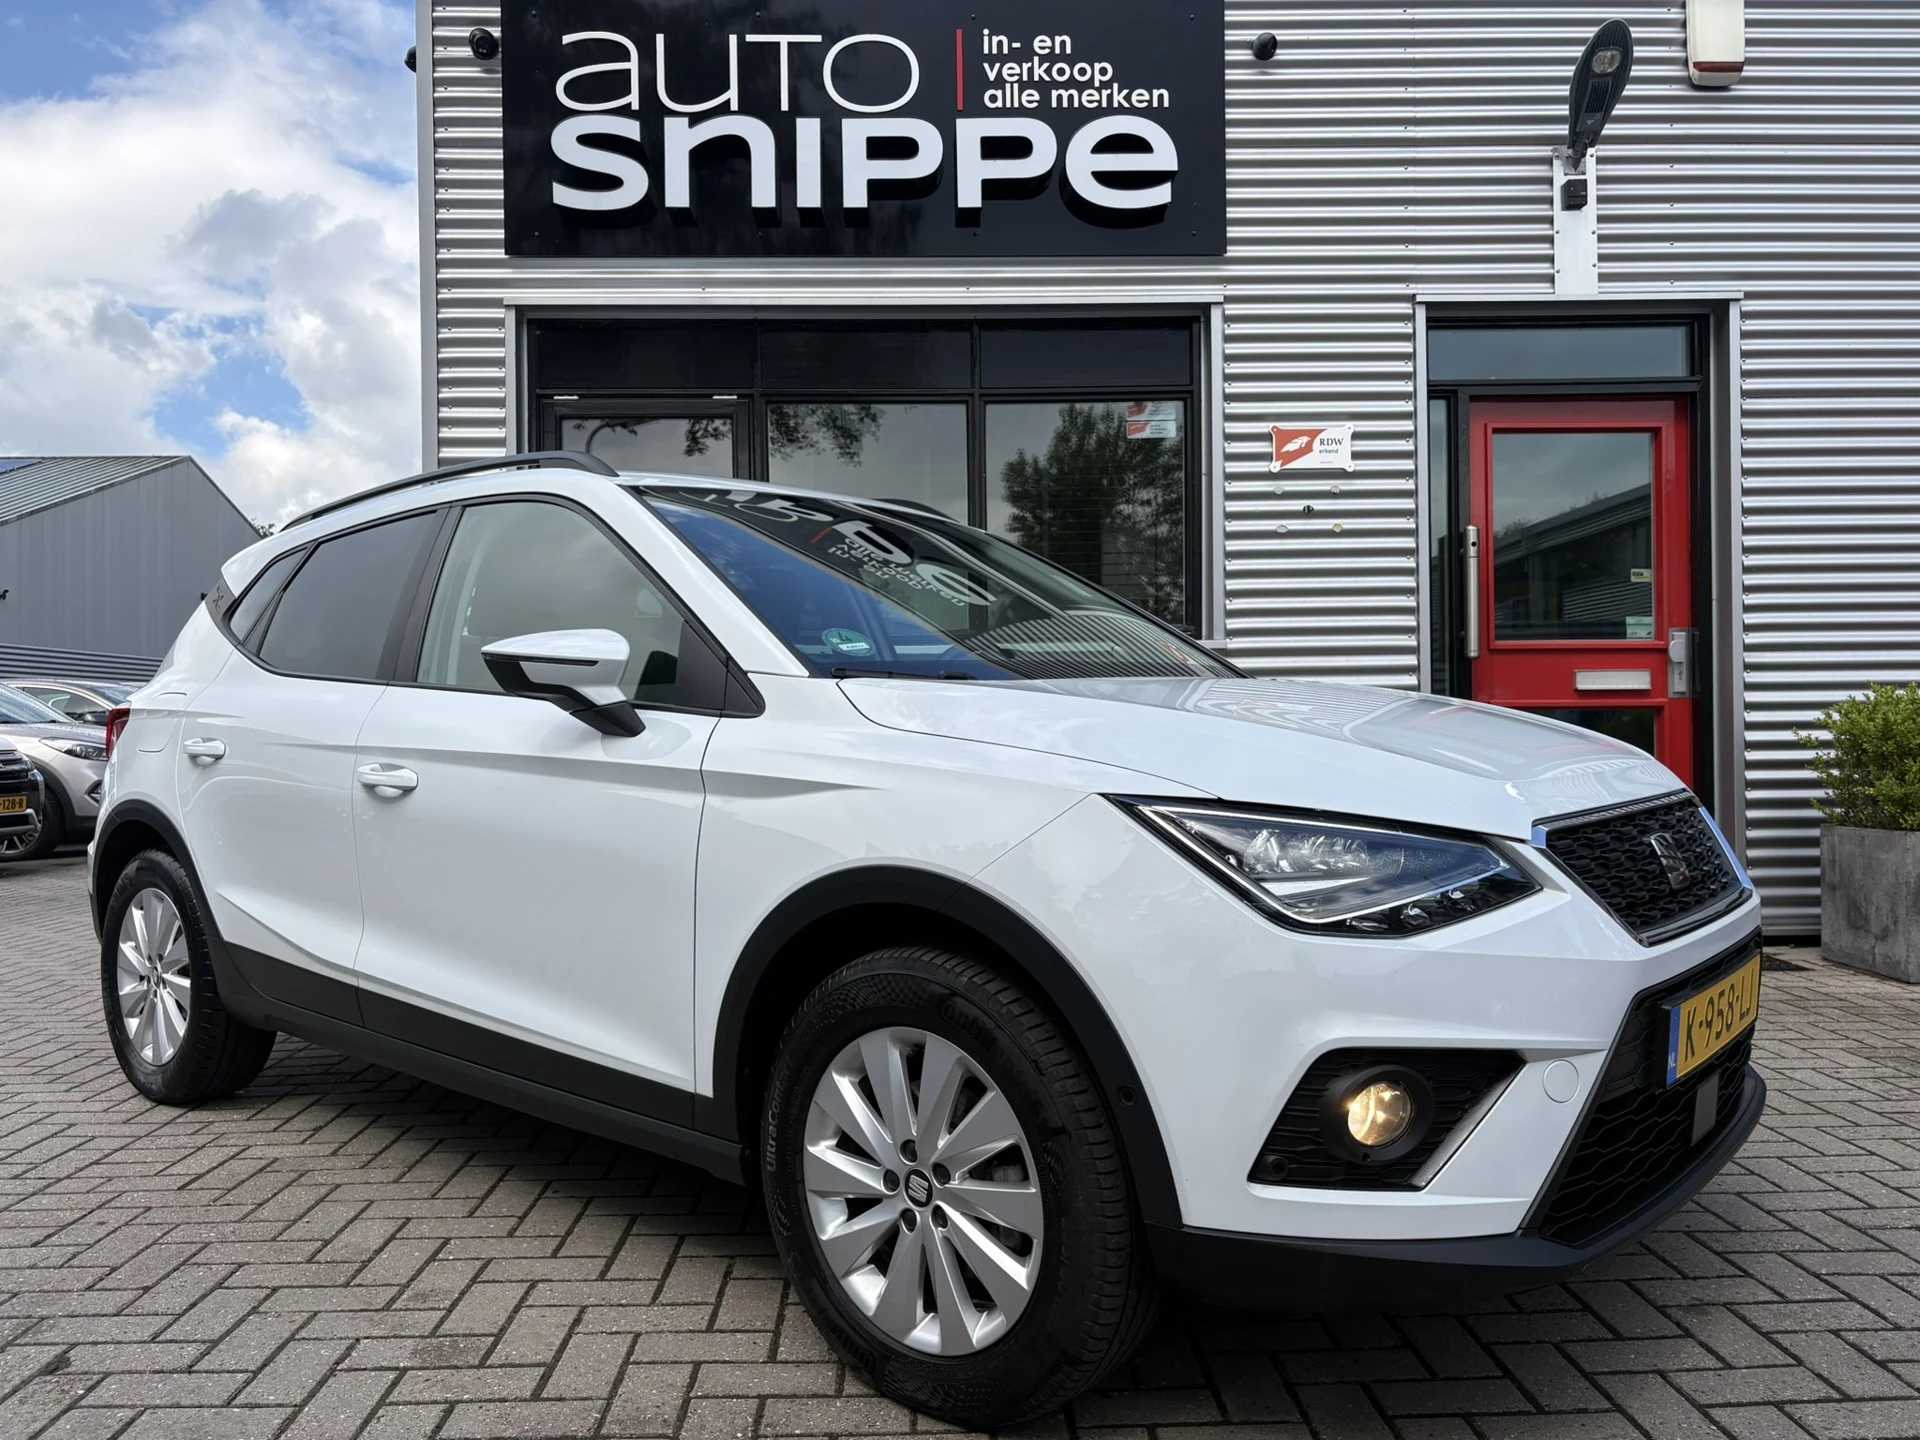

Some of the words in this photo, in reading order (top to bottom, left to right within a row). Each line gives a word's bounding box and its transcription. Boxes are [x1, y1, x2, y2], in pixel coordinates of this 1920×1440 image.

[982, 28, 1021, 55] in-
[1033, 35, 1072, 55] en
[982, 56, 1113, 88] verkoop
[983, 82, 1041, 109] alle
[1051, 82, 1170, 109] merken
[1319, 438, 1344, 446] RDW
[1684, 967, 1754, 1063] K-958-LJ
